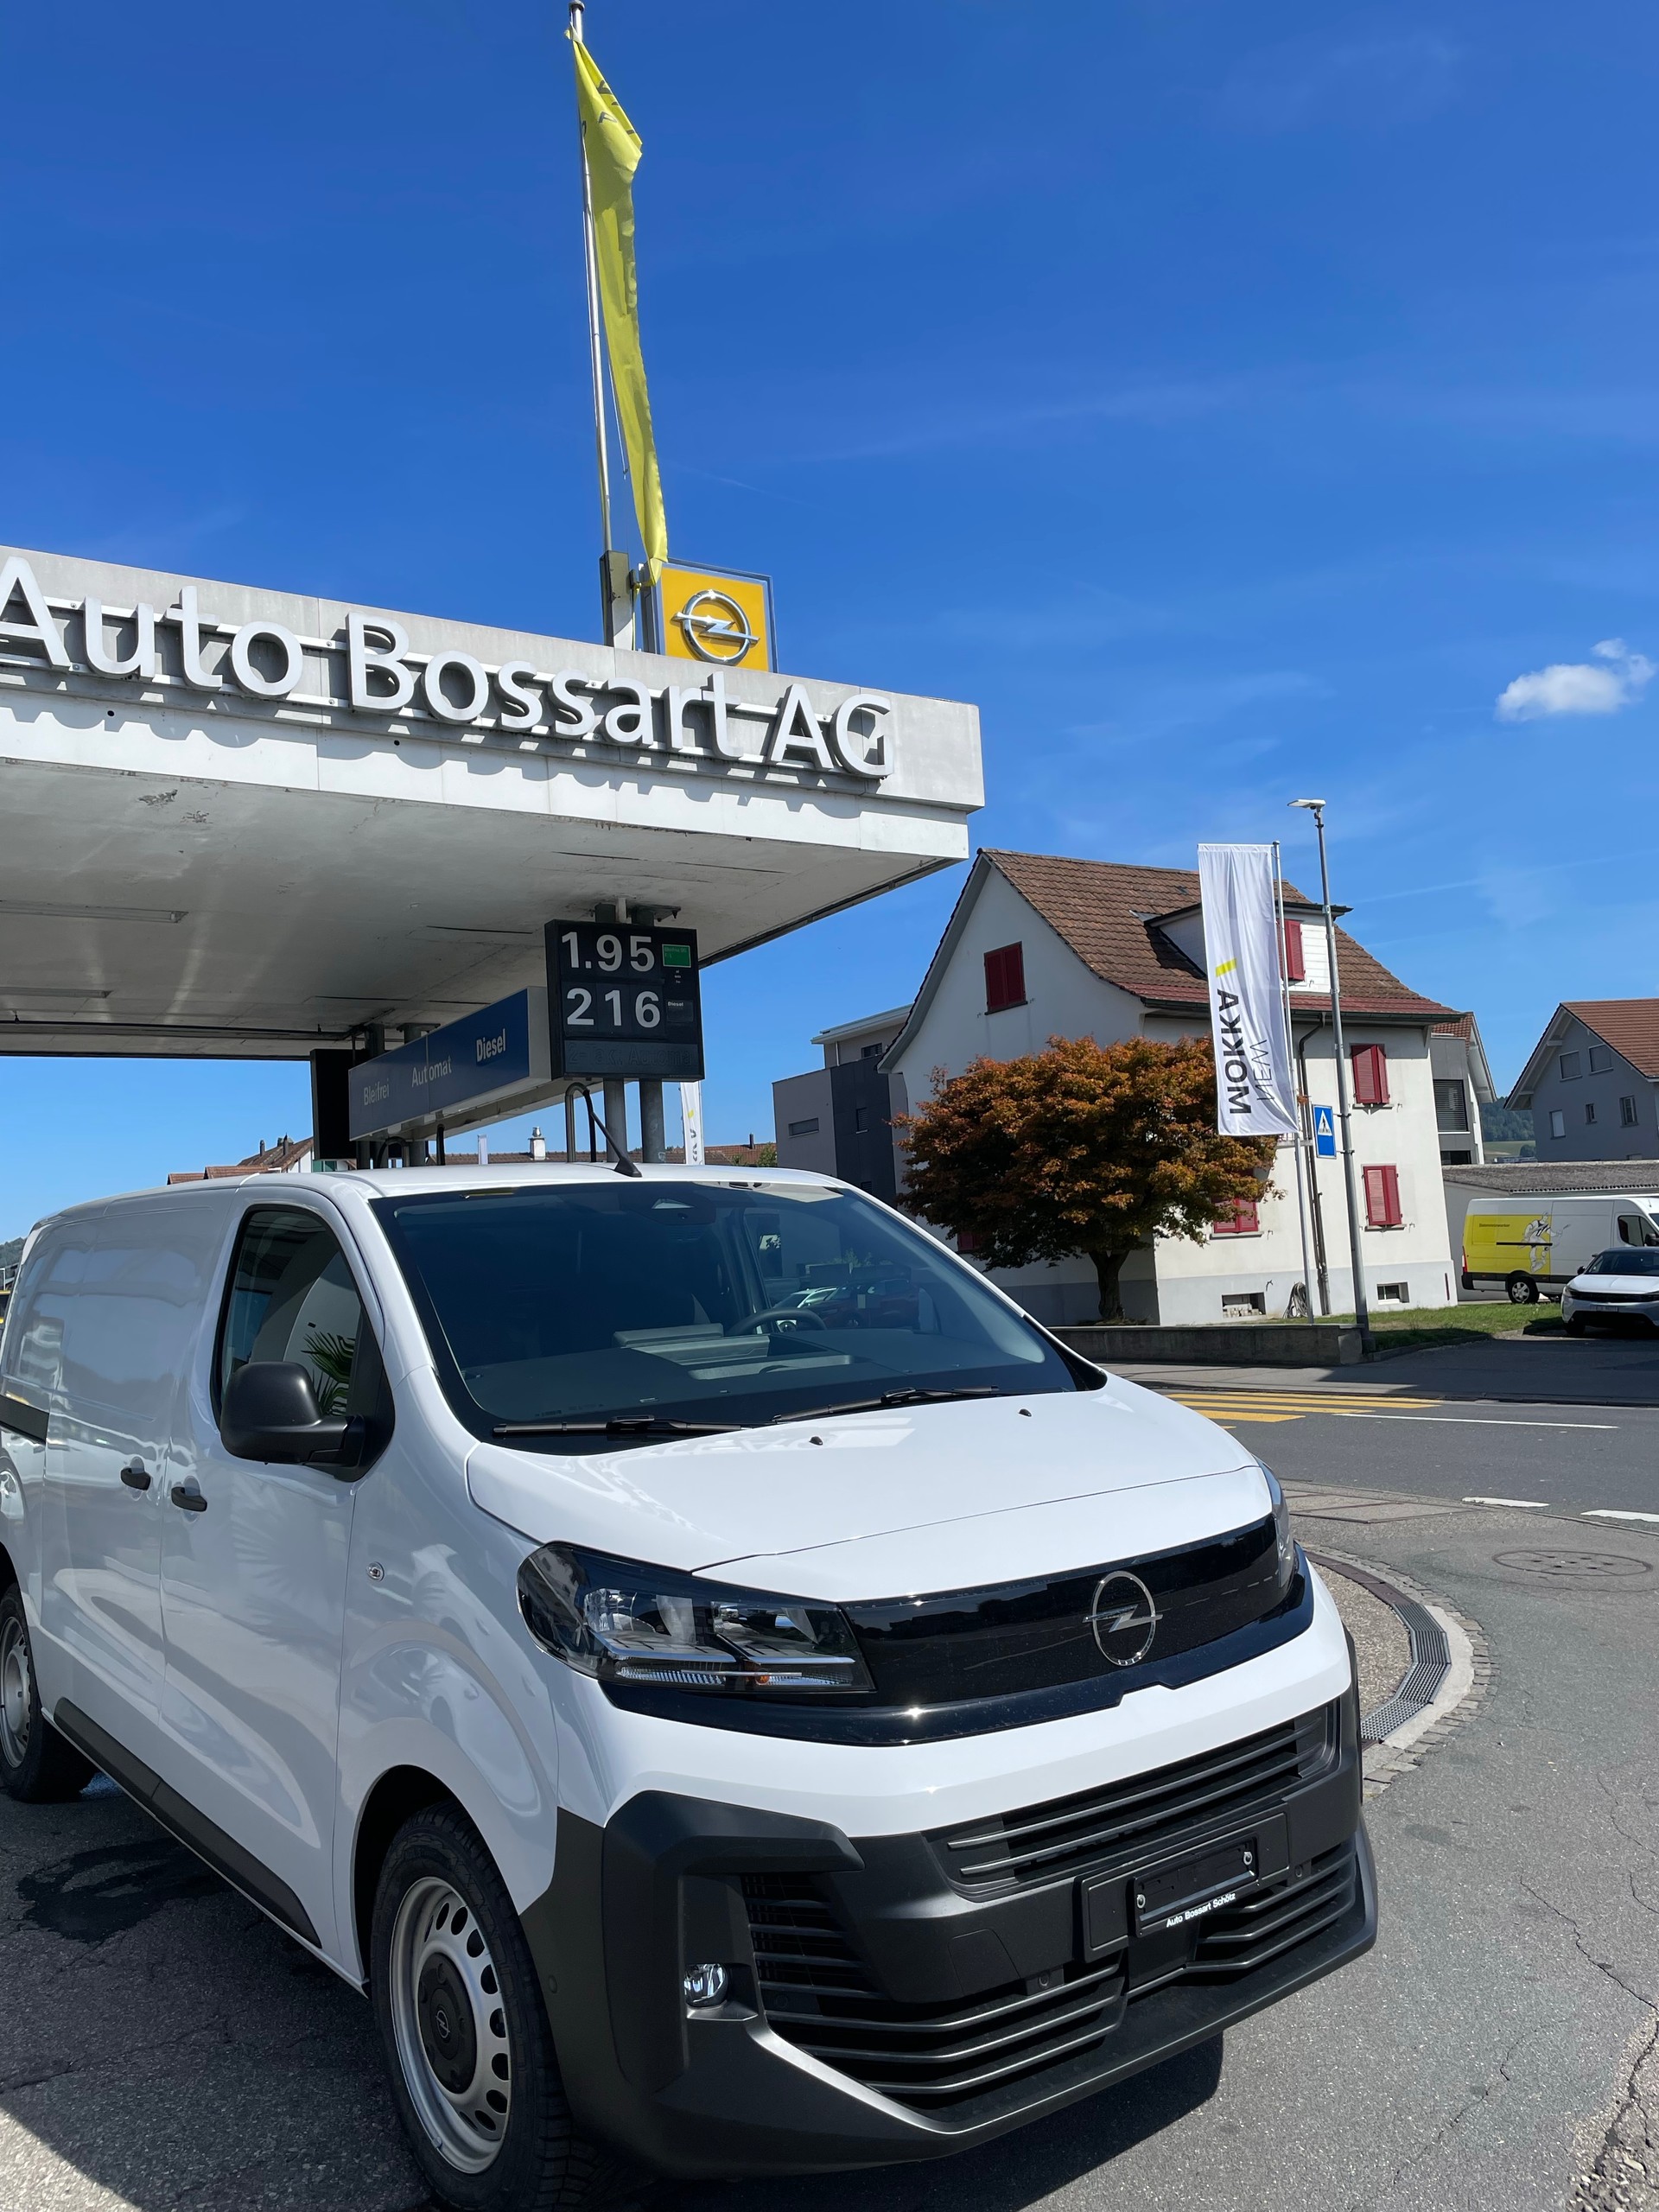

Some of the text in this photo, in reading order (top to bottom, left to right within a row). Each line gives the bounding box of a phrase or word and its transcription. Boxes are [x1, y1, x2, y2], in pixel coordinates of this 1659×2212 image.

[0, 556, 894, 779] Auto Bossart AG
[562, 931, 655, 972] 1.95
[566, 988, 661, 1028] 216
[476, 1027, 506, 1063] Diesel
[411, 1055, 452, 1088] Automat
[364, 1078, 390, 1106] Bleifrei
[1166, 1892, 1236, 1928] Auto Bossart Schötz
